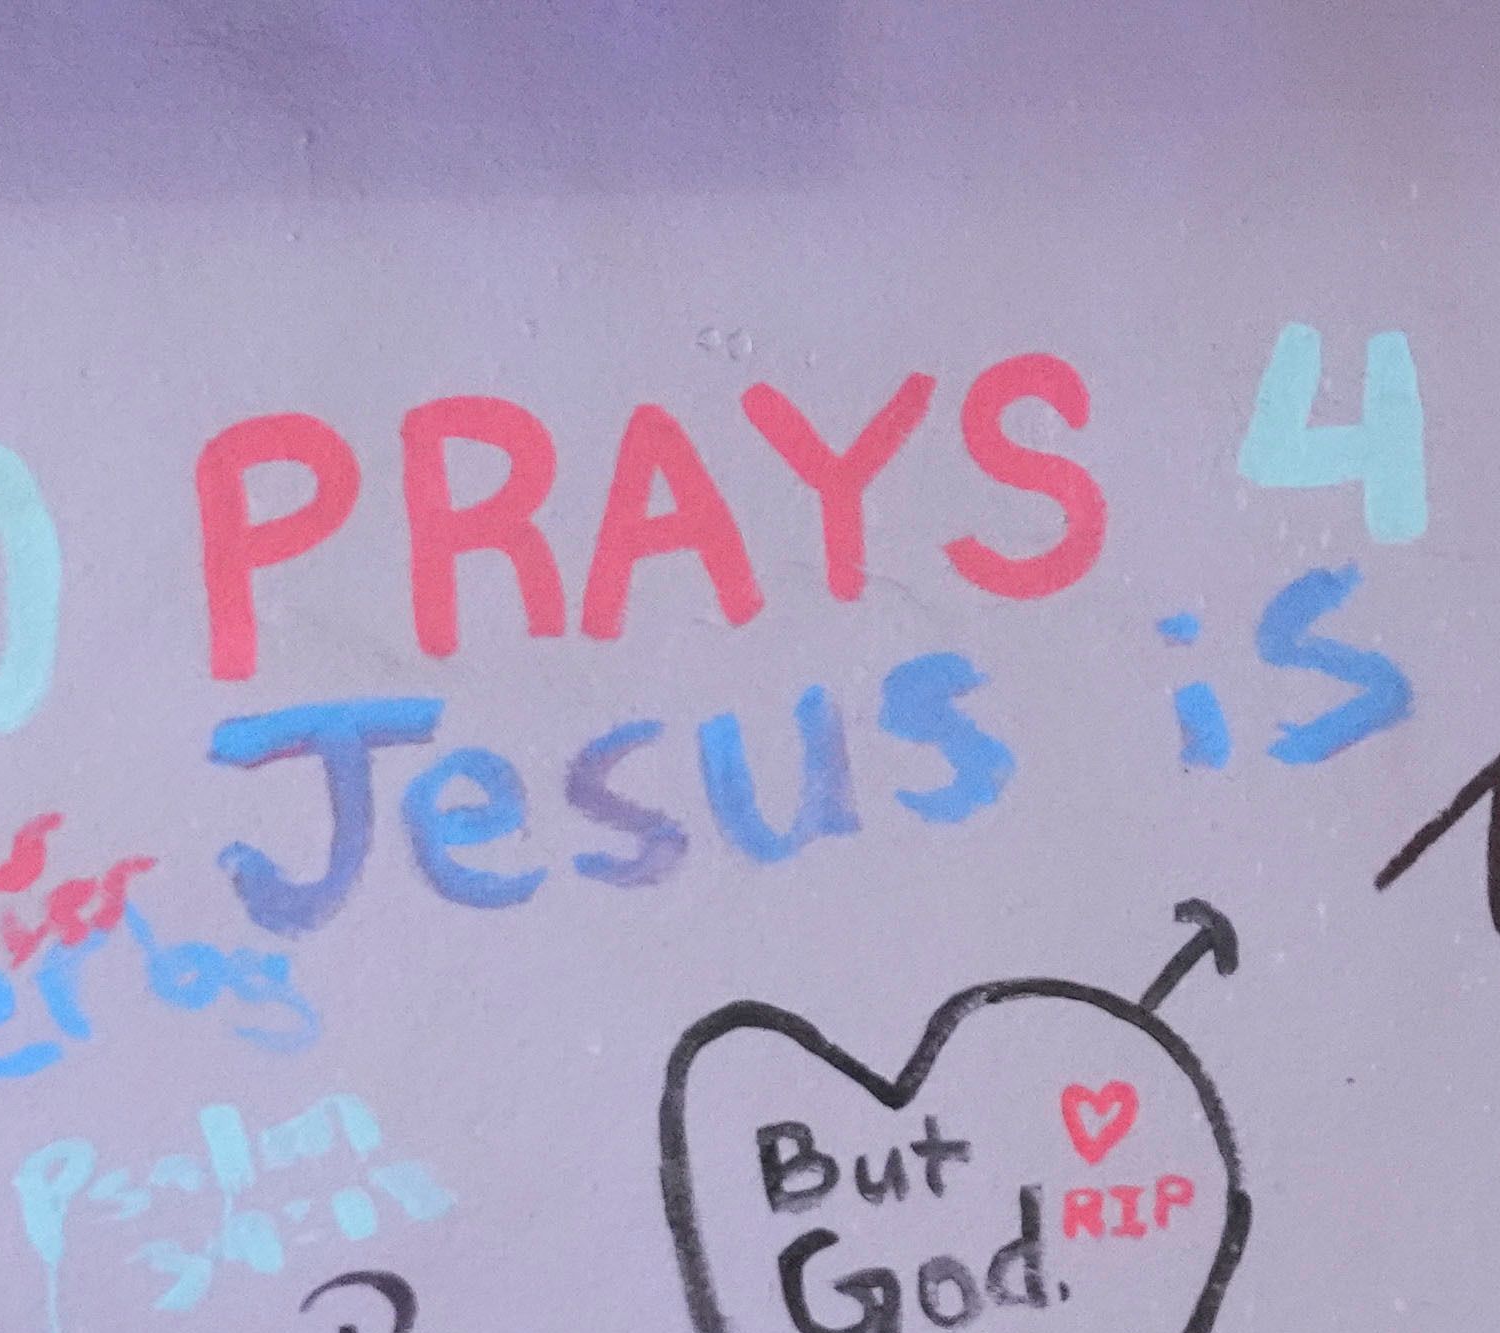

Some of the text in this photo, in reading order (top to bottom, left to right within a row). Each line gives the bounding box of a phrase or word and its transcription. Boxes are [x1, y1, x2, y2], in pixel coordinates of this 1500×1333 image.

[193, 352, 1106, 682] PRAYS
[1237, 322, 1426, 545] 4
[205, 650, 1016, 935] Jesus
[1155, 563, 1413, 770] is
[756, 1114, 972, 1212] But
[1060, 1174, 1196, 1240] RIP
